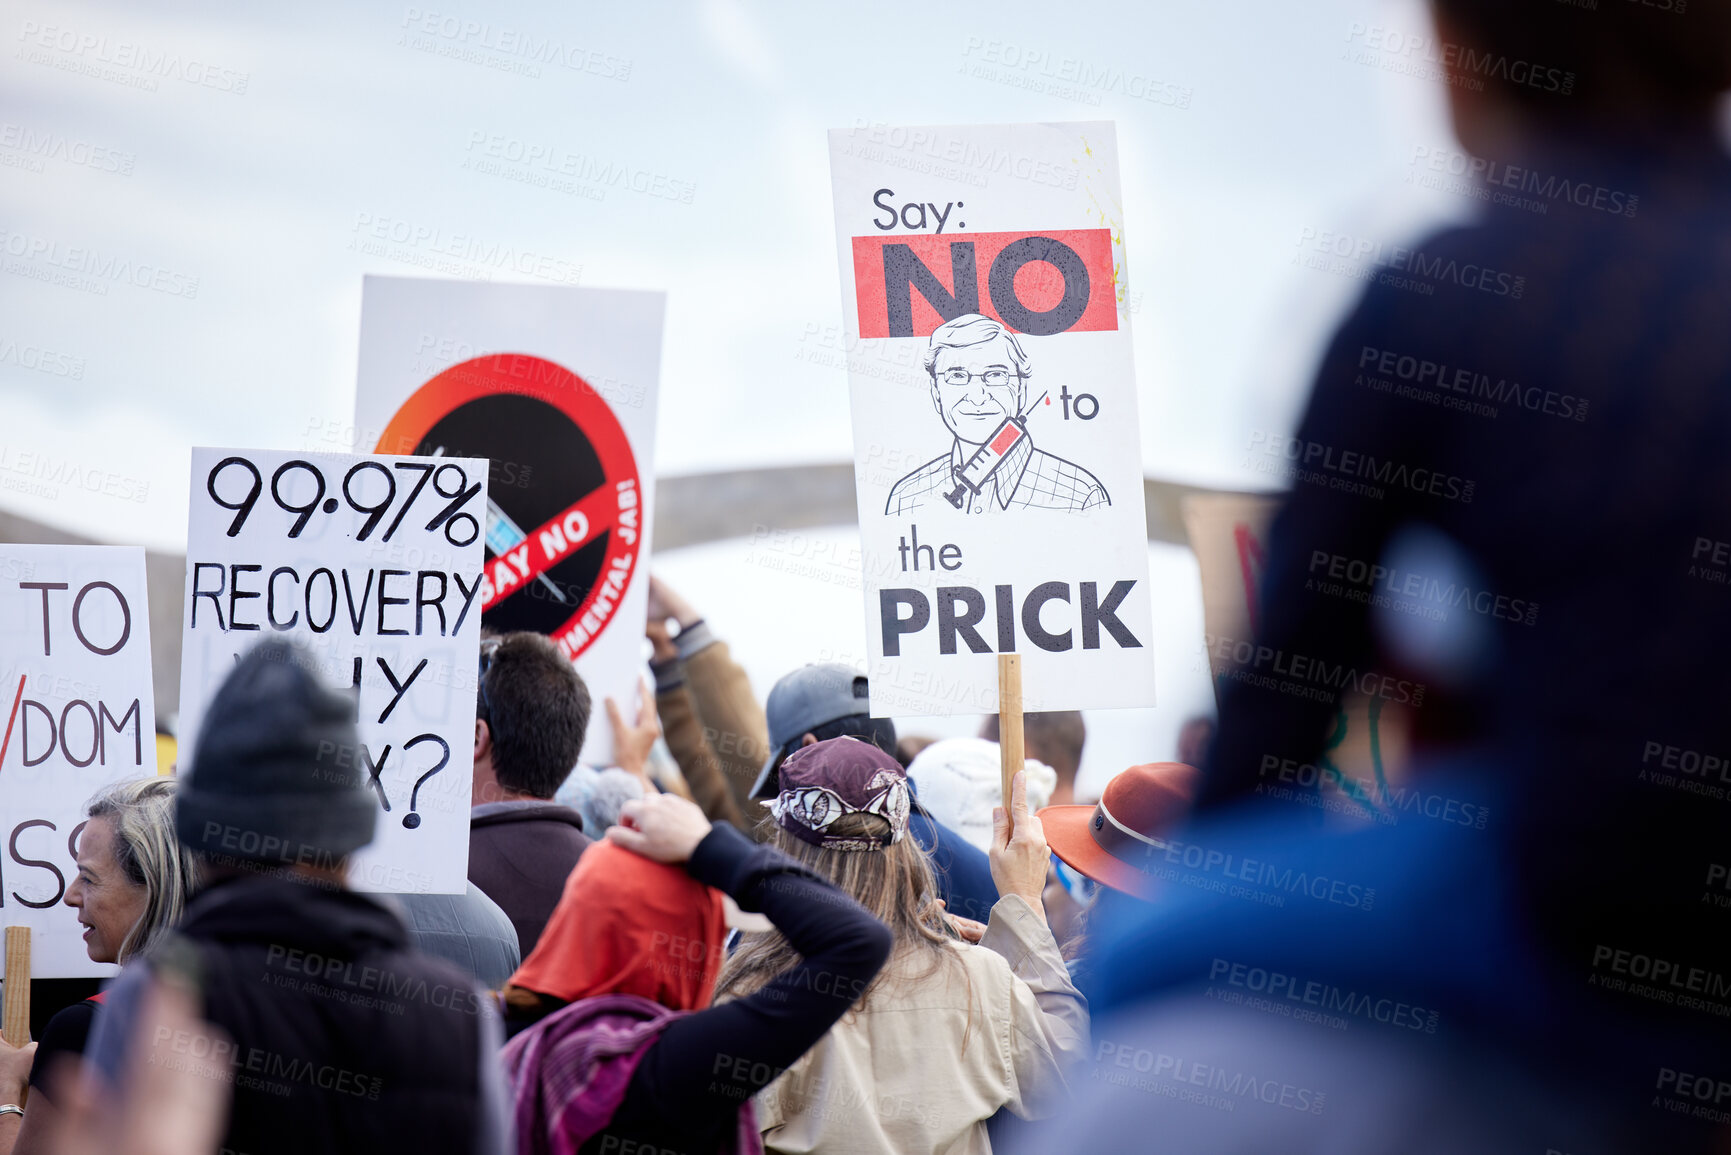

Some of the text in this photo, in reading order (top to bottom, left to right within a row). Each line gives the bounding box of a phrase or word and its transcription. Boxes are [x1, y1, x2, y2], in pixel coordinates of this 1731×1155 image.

[873, 188, 966, 234] Say:
[882, 236, 1090, 339] NO
[1060, 385, 1100, 421] to
[207, 456, 482, 548] 99.97%
[481, 545, 531, 606] SAY
[539, 510, 589, 561] NO
[558, 477, 638, 657] IMENTAL JAB!
[898, 524, 962, 572] the
[19, 580, 132, 657] TO
[191, 562, 483, 637] RECOVERY
[879, 580, 1144, 657] PRICK
